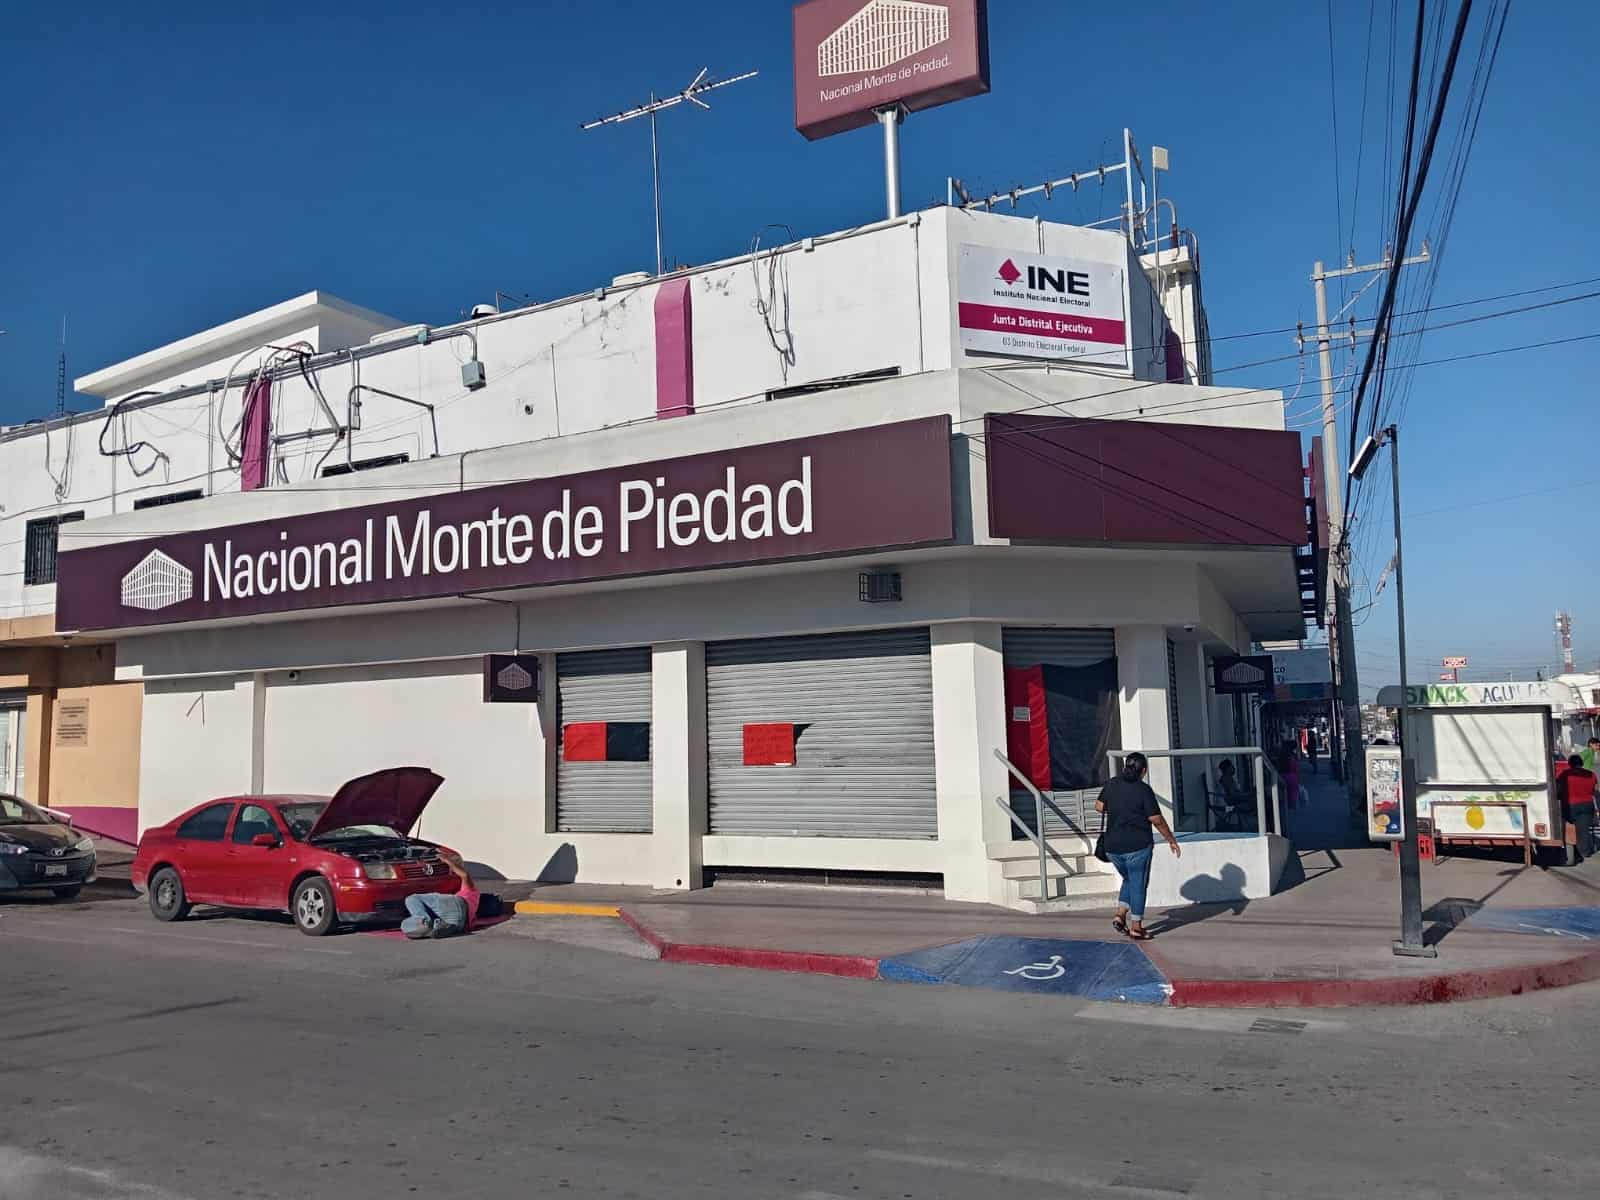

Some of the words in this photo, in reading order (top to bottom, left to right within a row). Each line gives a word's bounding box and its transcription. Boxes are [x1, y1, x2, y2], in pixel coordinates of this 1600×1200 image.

[820, 80, 862, 102] Nacional
[864, 71, 897, 89] Monte
[898, 66, 911, 80] de
[1028, 265, 1090, 296] INE
[993, 288, 1024, 299] Instituto
[1026, 292, 1057, 303] Nacional
[1060, 296, 1090, 307] Electoral
[992, 312, 1016, 326] Junta
[1018, 315, 1053, 330] Distrital
[1055, 320, 1093, 335] Ejecutiva
[1012, 337, 1035, 349] Distrito
[1036, 340, 1062, 352] Electoral
[1063, 343, 1086, 353] Federal
[203, 519, 373, 602] Nacional
[385, 506, 533, 580] Monte
[542, 489, 603, 561] de
[620, 456, 813, 552] Piedad
